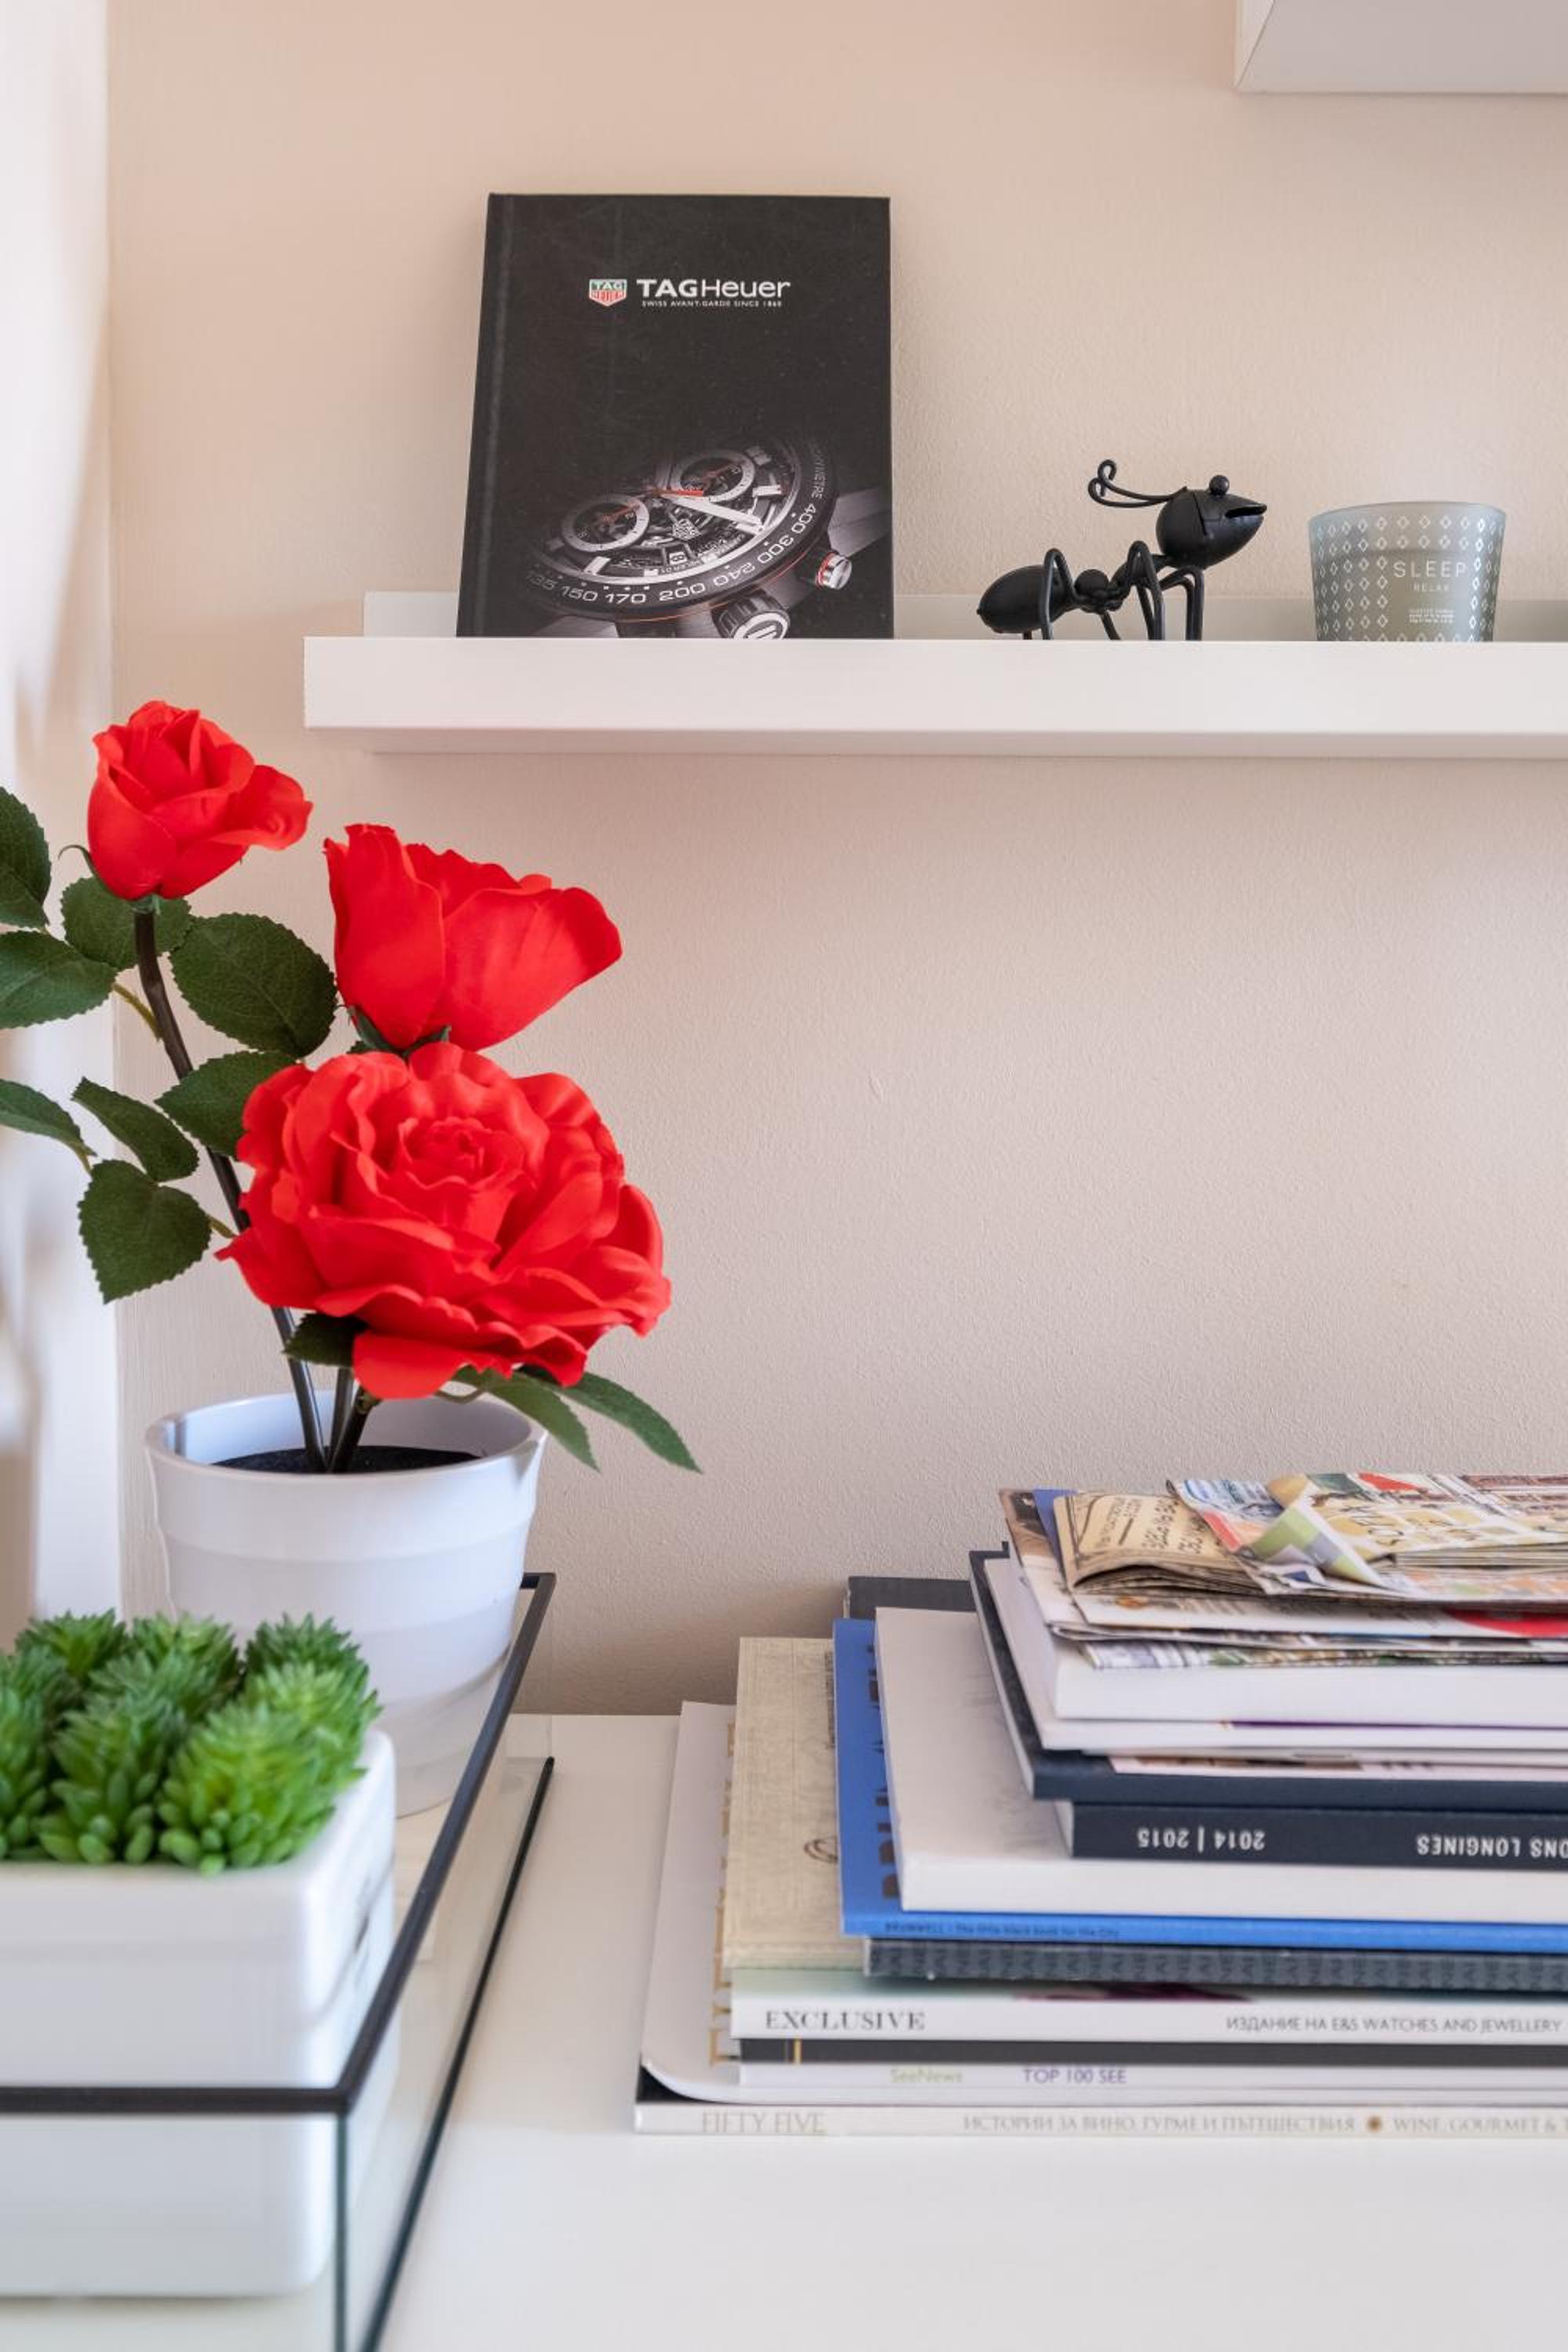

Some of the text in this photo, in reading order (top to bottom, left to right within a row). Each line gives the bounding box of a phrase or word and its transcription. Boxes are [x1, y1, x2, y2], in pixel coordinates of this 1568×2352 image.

[594, 280, 622, 291] TAG
[636, 278, 792, 299] TAGHeuer
[790, 502, 816, 534] 400
[757, 534, 794, 564] 300
[713, 562, 756, 586] 240
[1393, 560, 1468, 578] SLEEP
[561, 586, 598, 602] 150
[604, 593, 647, 604] 170
[659, 583, 706, 601] 200
[1137, 1827, 1190, 1849] 2015
[1214, 1829, 1265, 1851] 2014
[1416, 1834, 1522, 1857] LONGINES
[765, 2009, 926, 2030] EXCLUSIVE
[1226, 2016, 1300, 2031] ИЗДАНИЕ
[1305, 2017, 1327, 2031] НА
[1363, 2018, 1438, 2032] WATCHES
[1443, 2019, 1478, 2032] AND
[1479, 2019, 1563, 2034] JEWELLERY
[1023, 2069, 1127, 2084] TOP 100 SEE
[702, 2112, 827, 2134] FIFTY FIVE
